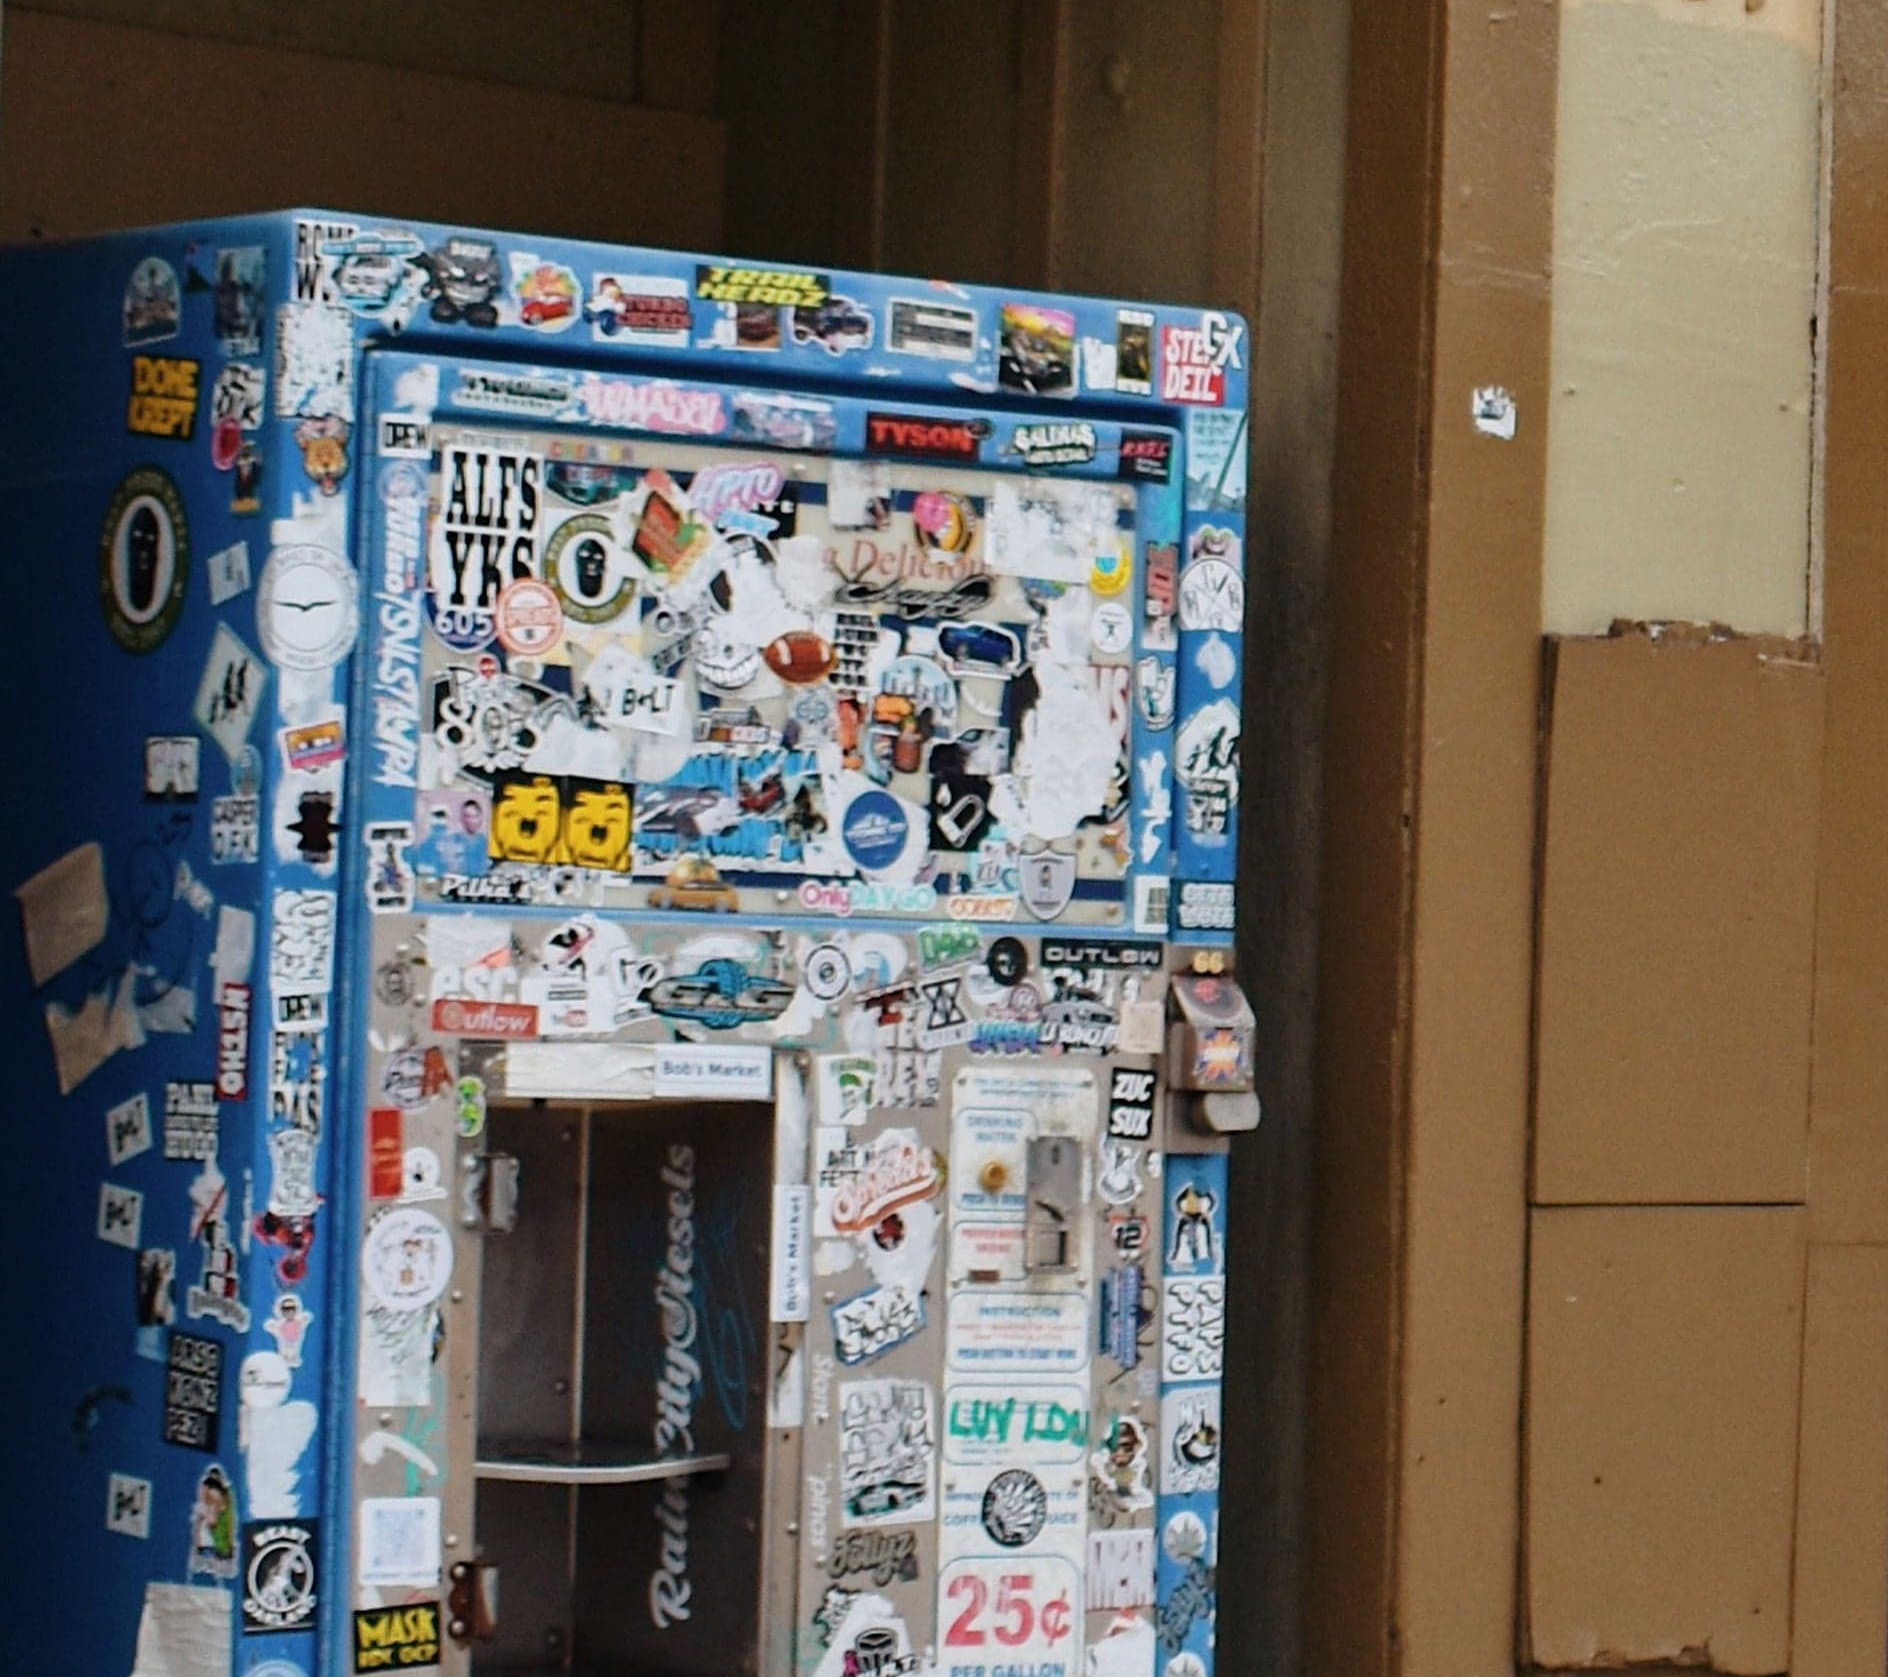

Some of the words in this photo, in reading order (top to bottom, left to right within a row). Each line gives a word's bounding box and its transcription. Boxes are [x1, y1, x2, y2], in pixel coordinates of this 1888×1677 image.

[434, 608, 494, 634] 605
[662, 1056, 702, 1078] Bob's
[707, 1059, 762, 1078] Market
[1113, 1074, 1153, 1102] ZUC
[1110, 1107, 1151, 1135] SUX
[943, 1574, 1072, 1648] 25¢
